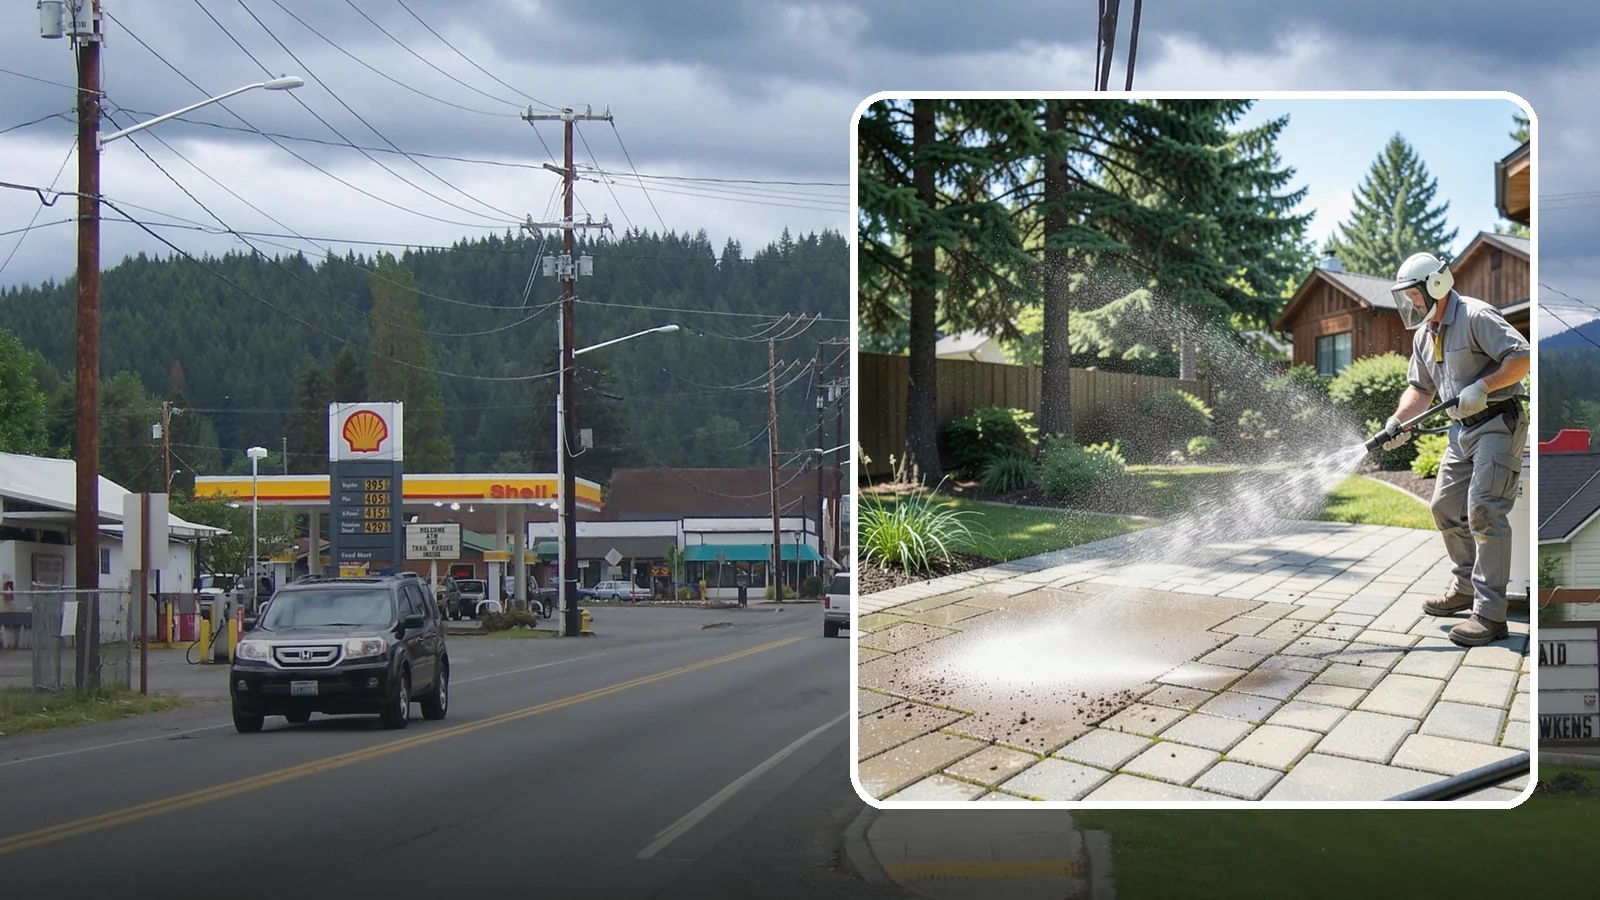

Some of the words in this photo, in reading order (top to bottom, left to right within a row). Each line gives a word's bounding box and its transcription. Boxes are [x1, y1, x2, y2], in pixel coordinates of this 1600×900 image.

[366, 480, 384, 490] 395
[490, 484, 547, 499] Shell
[365, 494, 384, 504] 405
[366, 508, 384, 518] 415
[366, 522, 384, 533] 429
[1538, 643, 1567, 665] AID
[1538, 716, 1592, 738] WKENS
